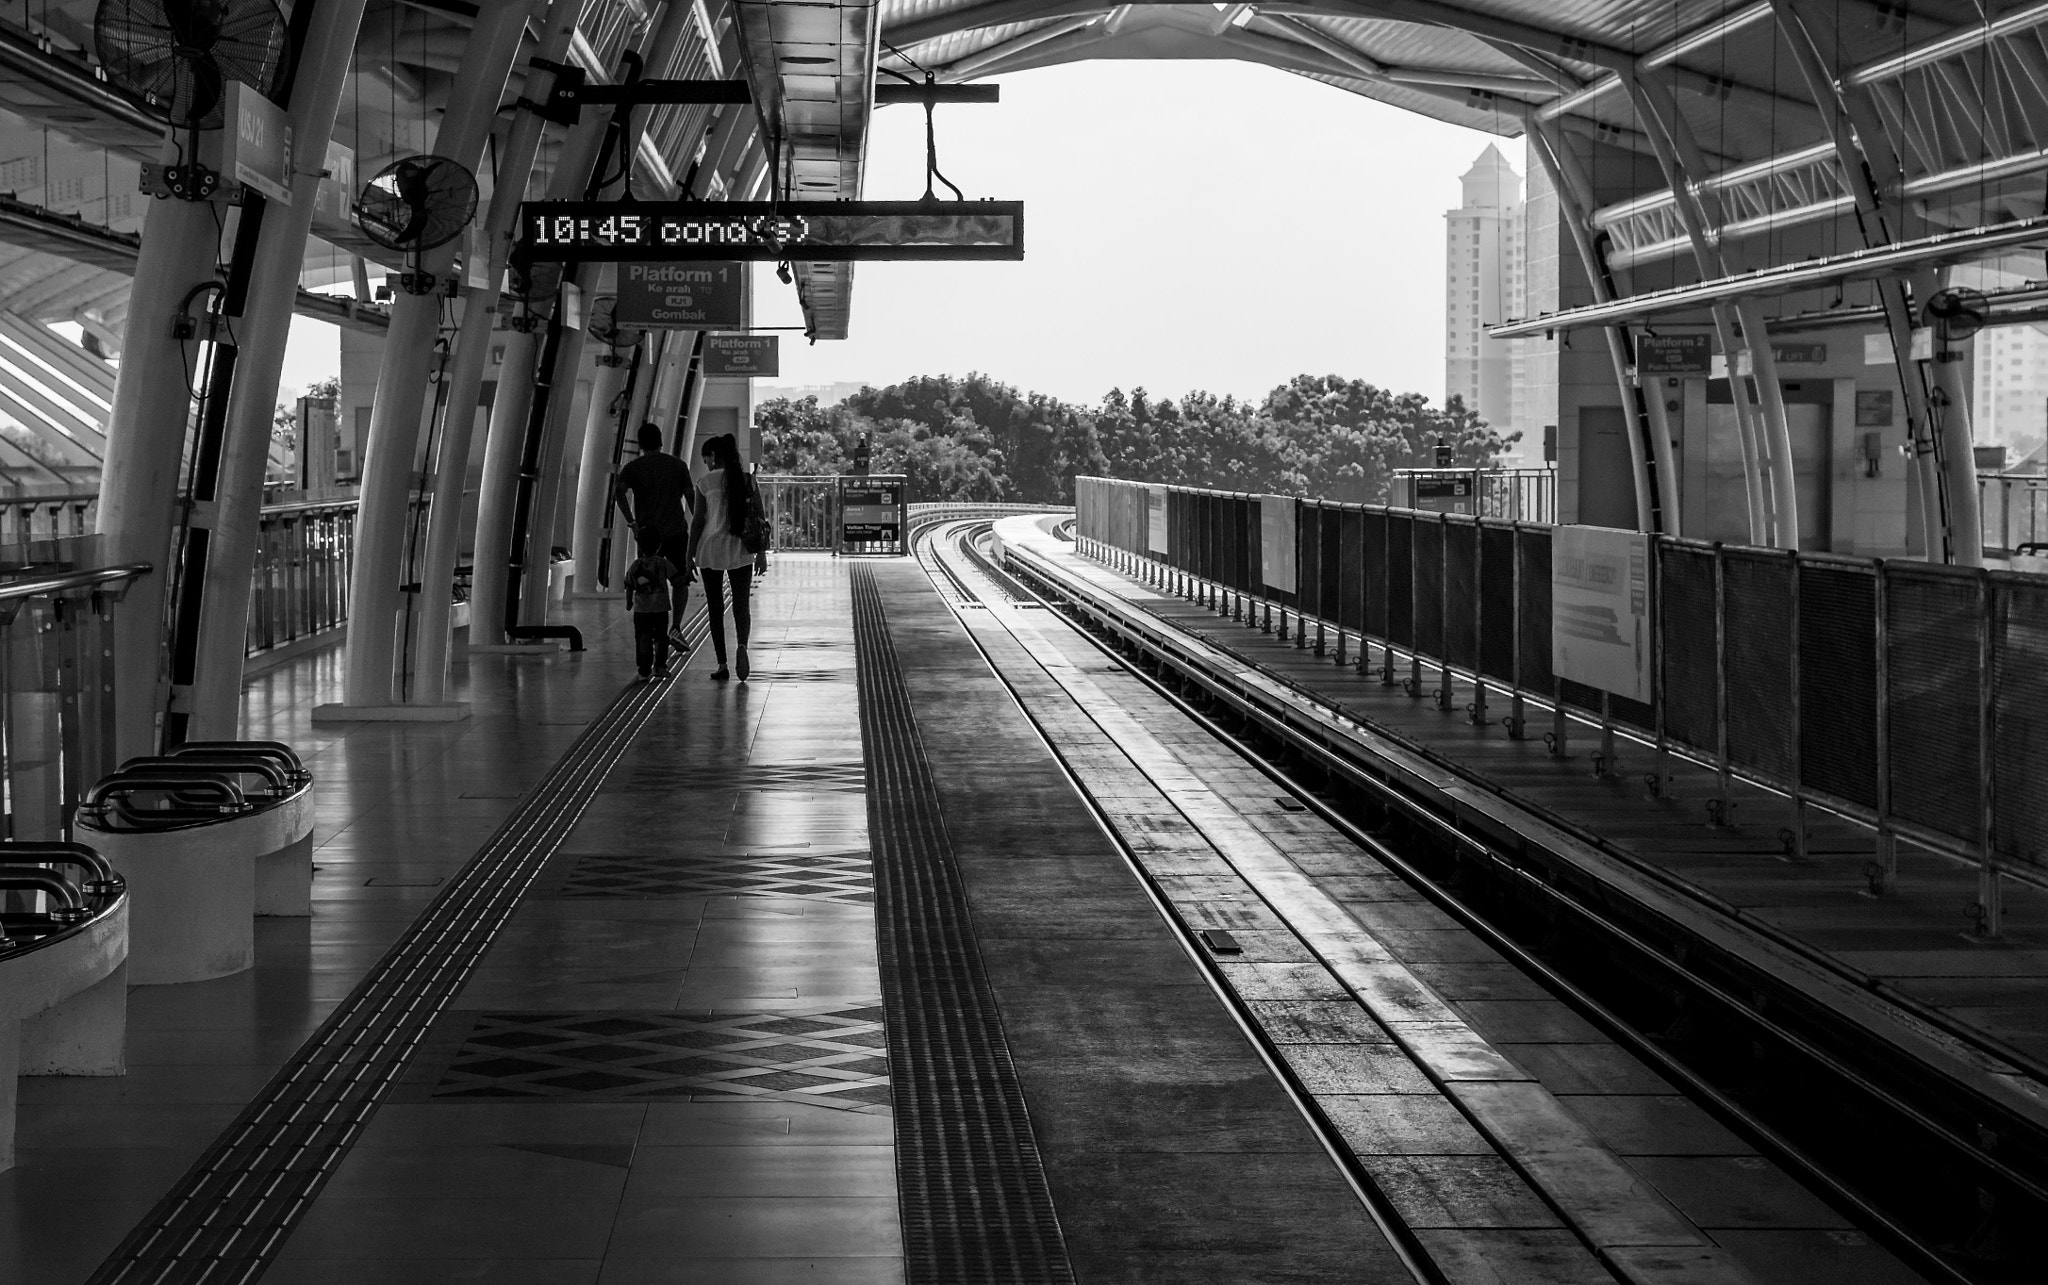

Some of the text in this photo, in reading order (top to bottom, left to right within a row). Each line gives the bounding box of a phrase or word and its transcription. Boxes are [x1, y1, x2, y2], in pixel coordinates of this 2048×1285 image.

[536, 215, 641, 243] 10:45
[629, 265, 728, 283] Platform 1
[647, 283, 663, 293] Ke
[665, 284, 691, 294] arah
[651, 308, 706, 320] Gombak
[710, 338, 771, 348] Platform 1
[1644, 336, 1705, 347] Platform 2
